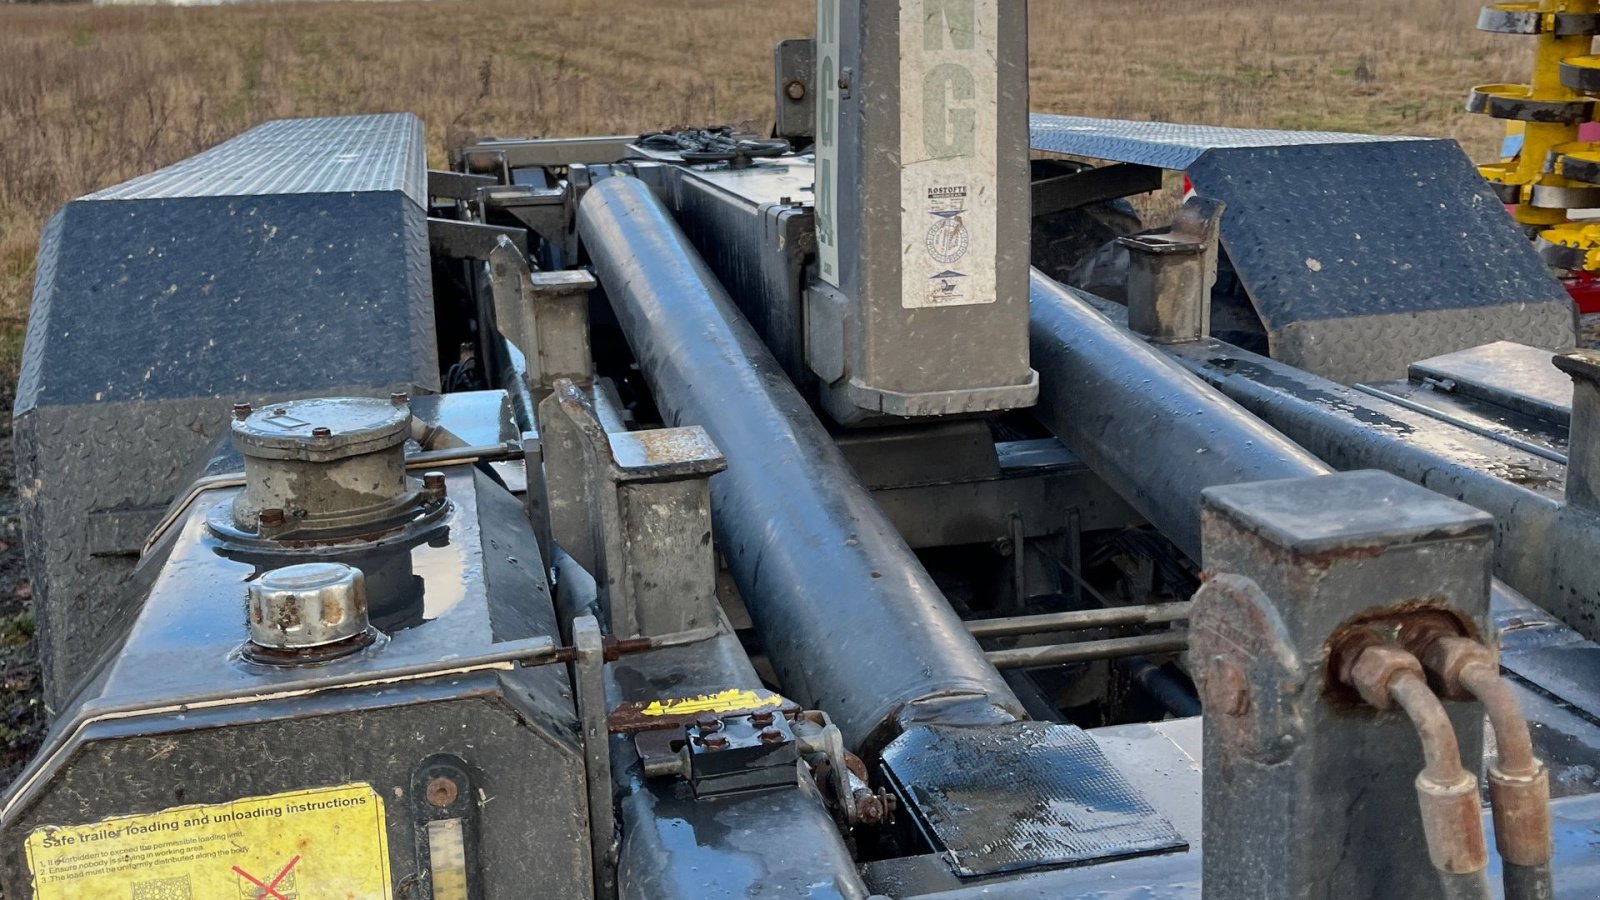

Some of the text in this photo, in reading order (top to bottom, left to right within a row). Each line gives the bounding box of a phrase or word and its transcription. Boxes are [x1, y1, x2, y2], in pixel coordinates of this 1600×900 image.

[43, 796, 367, 849] Safe trailer loading and unloading instructions
[49, 863, 78, 874] Ensure
[79, 858, 108, 870] nobody
[146, 853, 154, 861] in
[154, 847, 185, 860] working
[62, 852, 100, 865] forbidden
[110, 846, 139, 856] exceed
[139, 843, 152, 852] the
[153, 838, 197, 852] permissible
[198, 832, 226, 843] loading
[50, 873, 65, 883] The
[66, 870, 84, 880] load
[85, 868, 104, 877] must
[105, 866, 116, 875] be
[116, 860, 153, 874] uniformly
[154, 855, 194, 867] distributed
[195, 851, 217, 862] along
[217, 849, 230, 857] the
